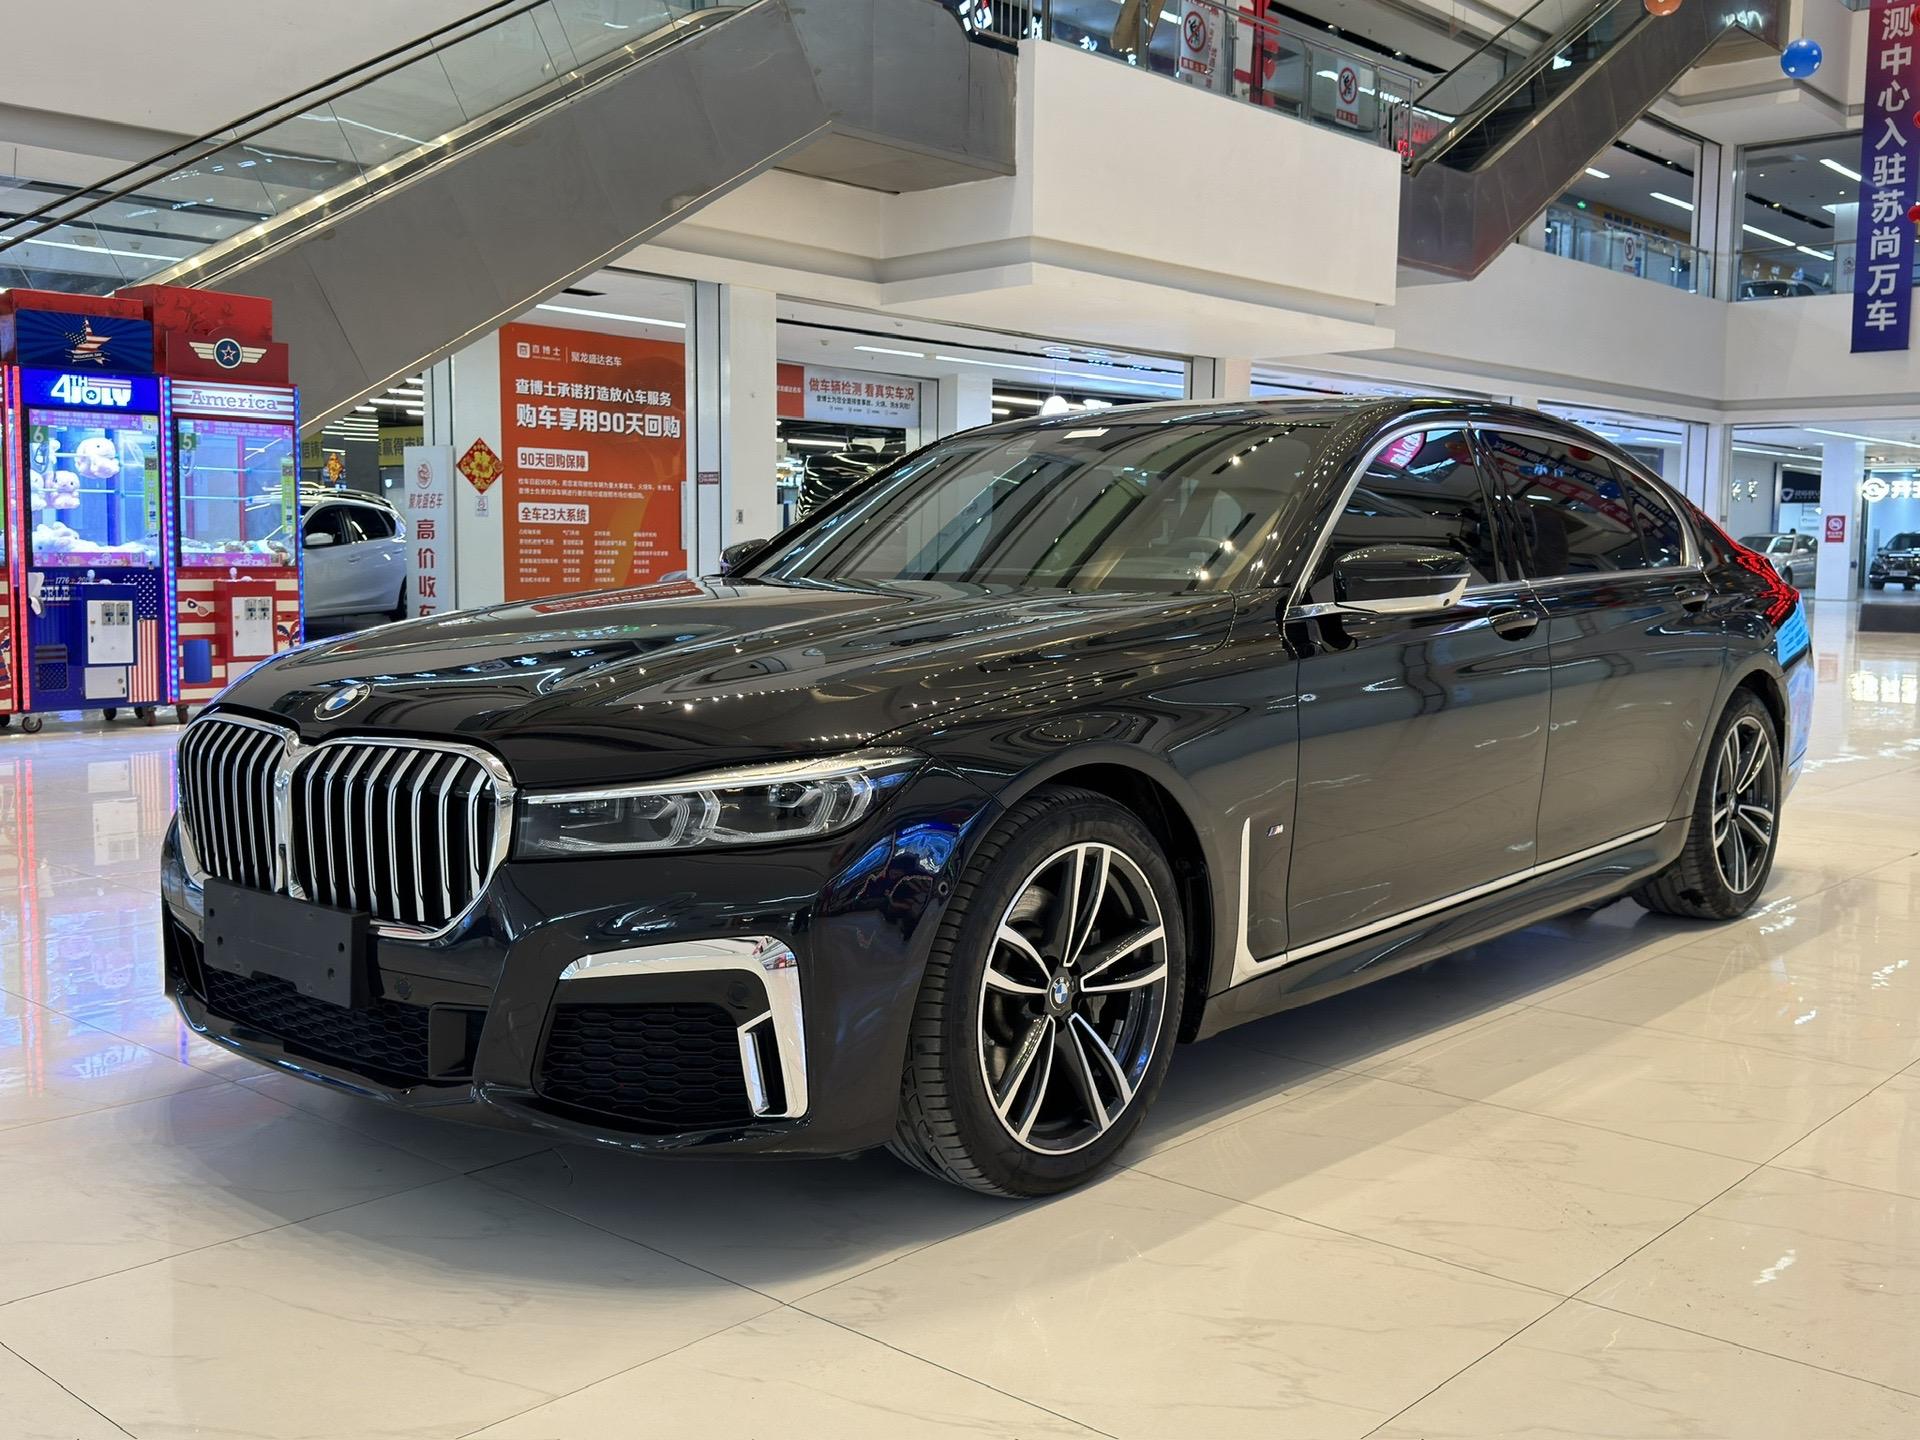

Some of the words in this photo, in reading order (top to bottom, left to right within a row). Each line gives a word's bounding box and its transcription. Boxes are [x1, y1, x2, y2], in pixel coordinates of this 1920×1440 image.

[1864, 0, 1915, 332] 测中心入驻苏尚万车
[515, 377, 672, 407] 查博士承诺打造放心车服务
[809, 377, 862, 396] 做车辆检测
[865, 383, 915, 400] 看真实车况
[190, 390, 279, 410] America
[516, 403, 681, 438] 购车享用90天回购
[33, 426, 44, 443] 6
[182, 433, 193, 450] 5
[520, 451, 586, 470] 90天回购保障
[521, 507, 587, 523] 全车23大系统
